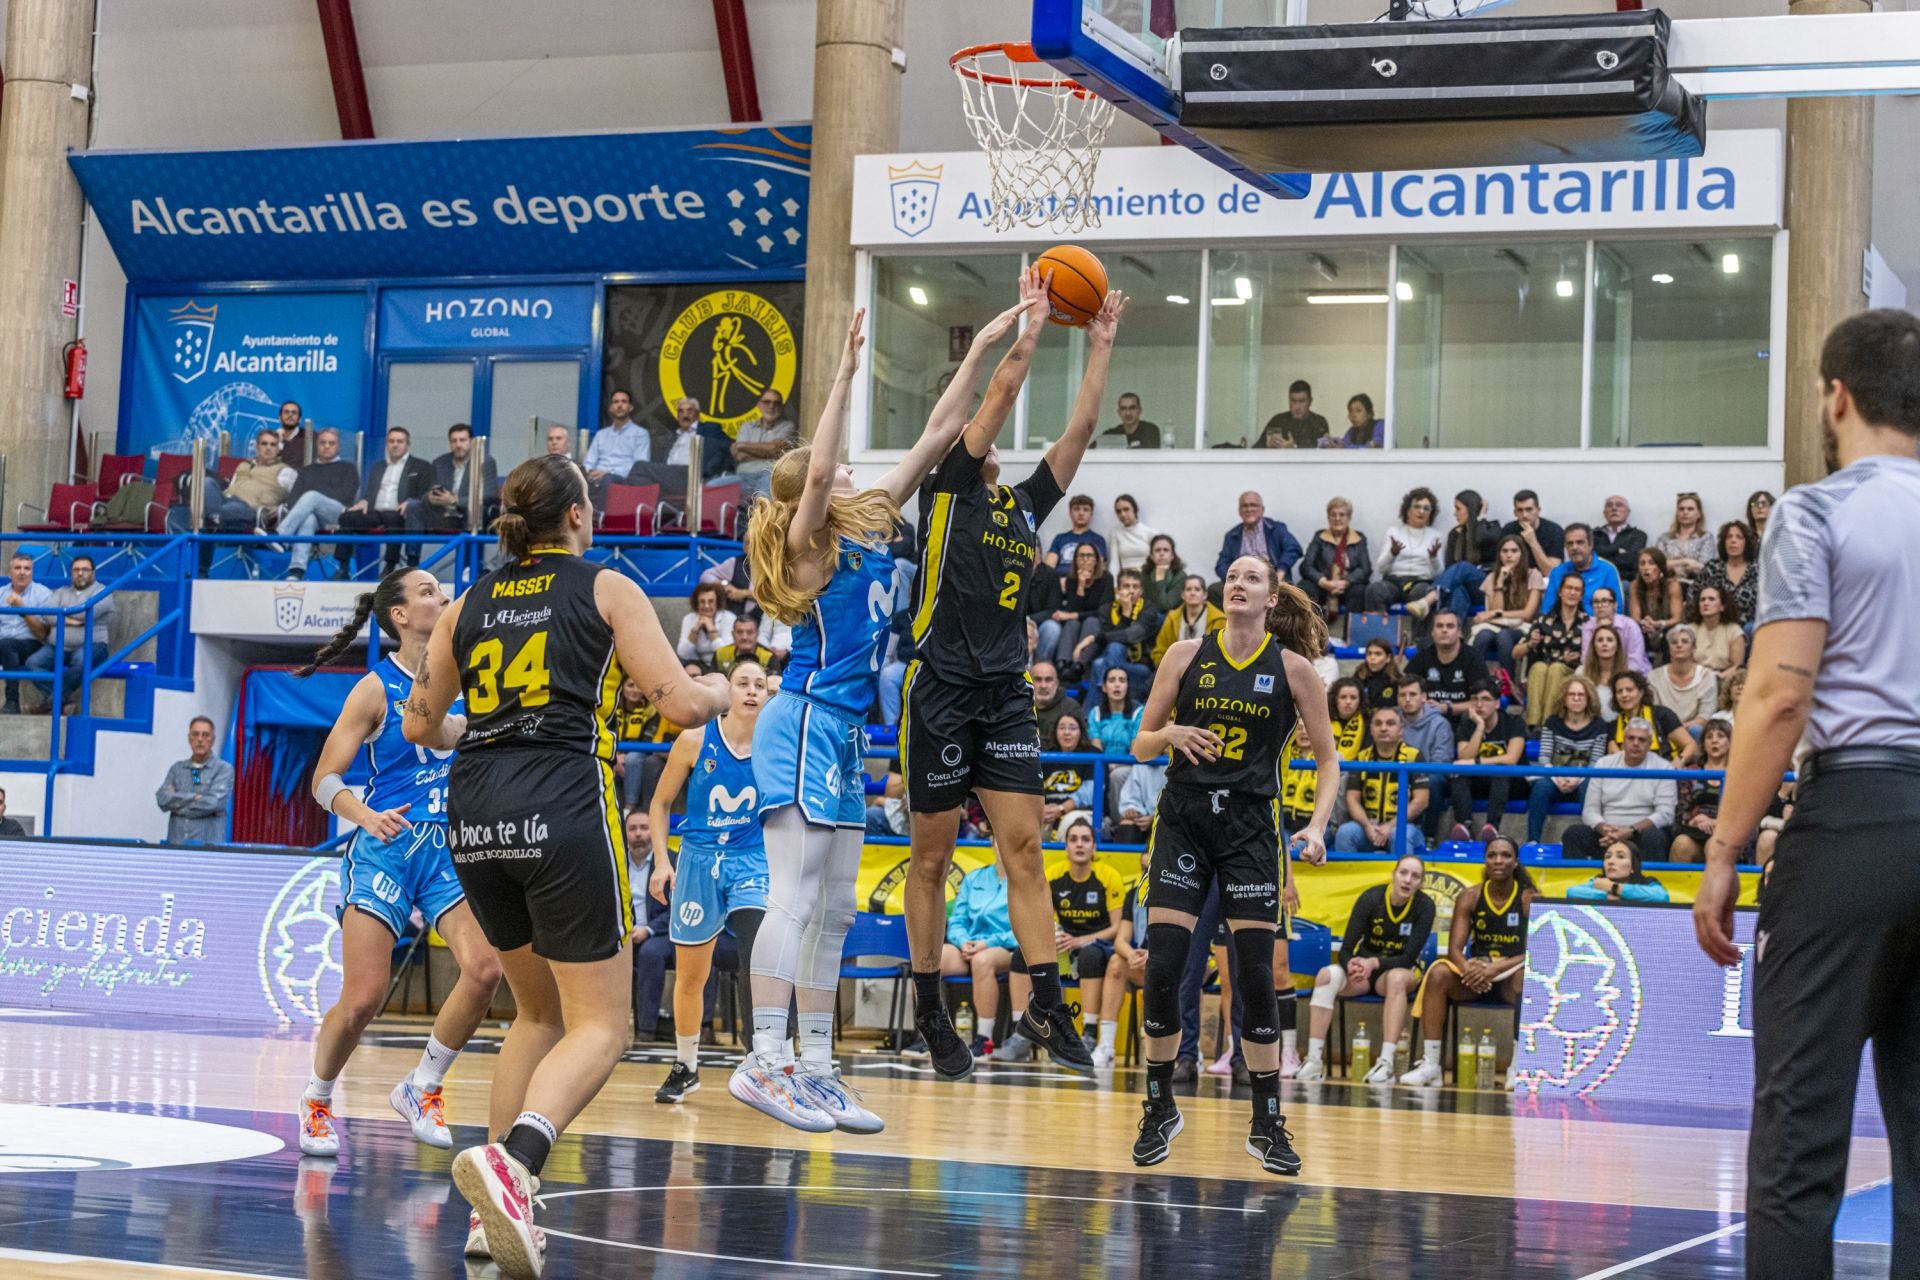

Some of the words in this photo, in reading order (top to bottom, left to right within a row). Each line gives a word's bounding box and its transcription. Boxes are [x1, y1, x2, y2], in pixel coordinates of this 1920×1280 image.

[1218, 184, 1261, 214] de
[1313, 159, 1736, 219] Alcantarilla
[131, 192, 407, 235] Alcantarilla
[421, 198, 478, 228] es
[493, 184, 706, 234] deporte
[425, 297, 553, 323] HOZONO
[470, 327, 511, 338] GLOBAL
[663, 299, 713, 360] CLUB
[721, 292, 793, 356] JAIRIS
[242, 334, 321, 349] Ayuntamiento
[323, 333, 339, 346] de
[213, 349, 338, 373] Alcantarilla
[982, 531, 1035, 561] HOZON
[491, 573, 556, 599] MASSEY
[998, 570, 1021, 611] 2
[500, 605, 552, 624] Hacienda
[467, 630, 551, 714] 34
[1195, 697, 1271, 719] HOZONO
[927, 772, 951, 781] Costa
[460, 819, 493, 848] boca
[496, 820, 517, 846] te
[523, 813, 549, 844] lía
[467, 850, 487, 864] QUE
[485, 848, 543, 860] BOCADILLOS
[376, 872, 401, 902] hp
[1160, 869, 1181, 881] Costa
[1225, 882, 1276, 892] Alcantarilla
[682, 901, 702, 927] hp
